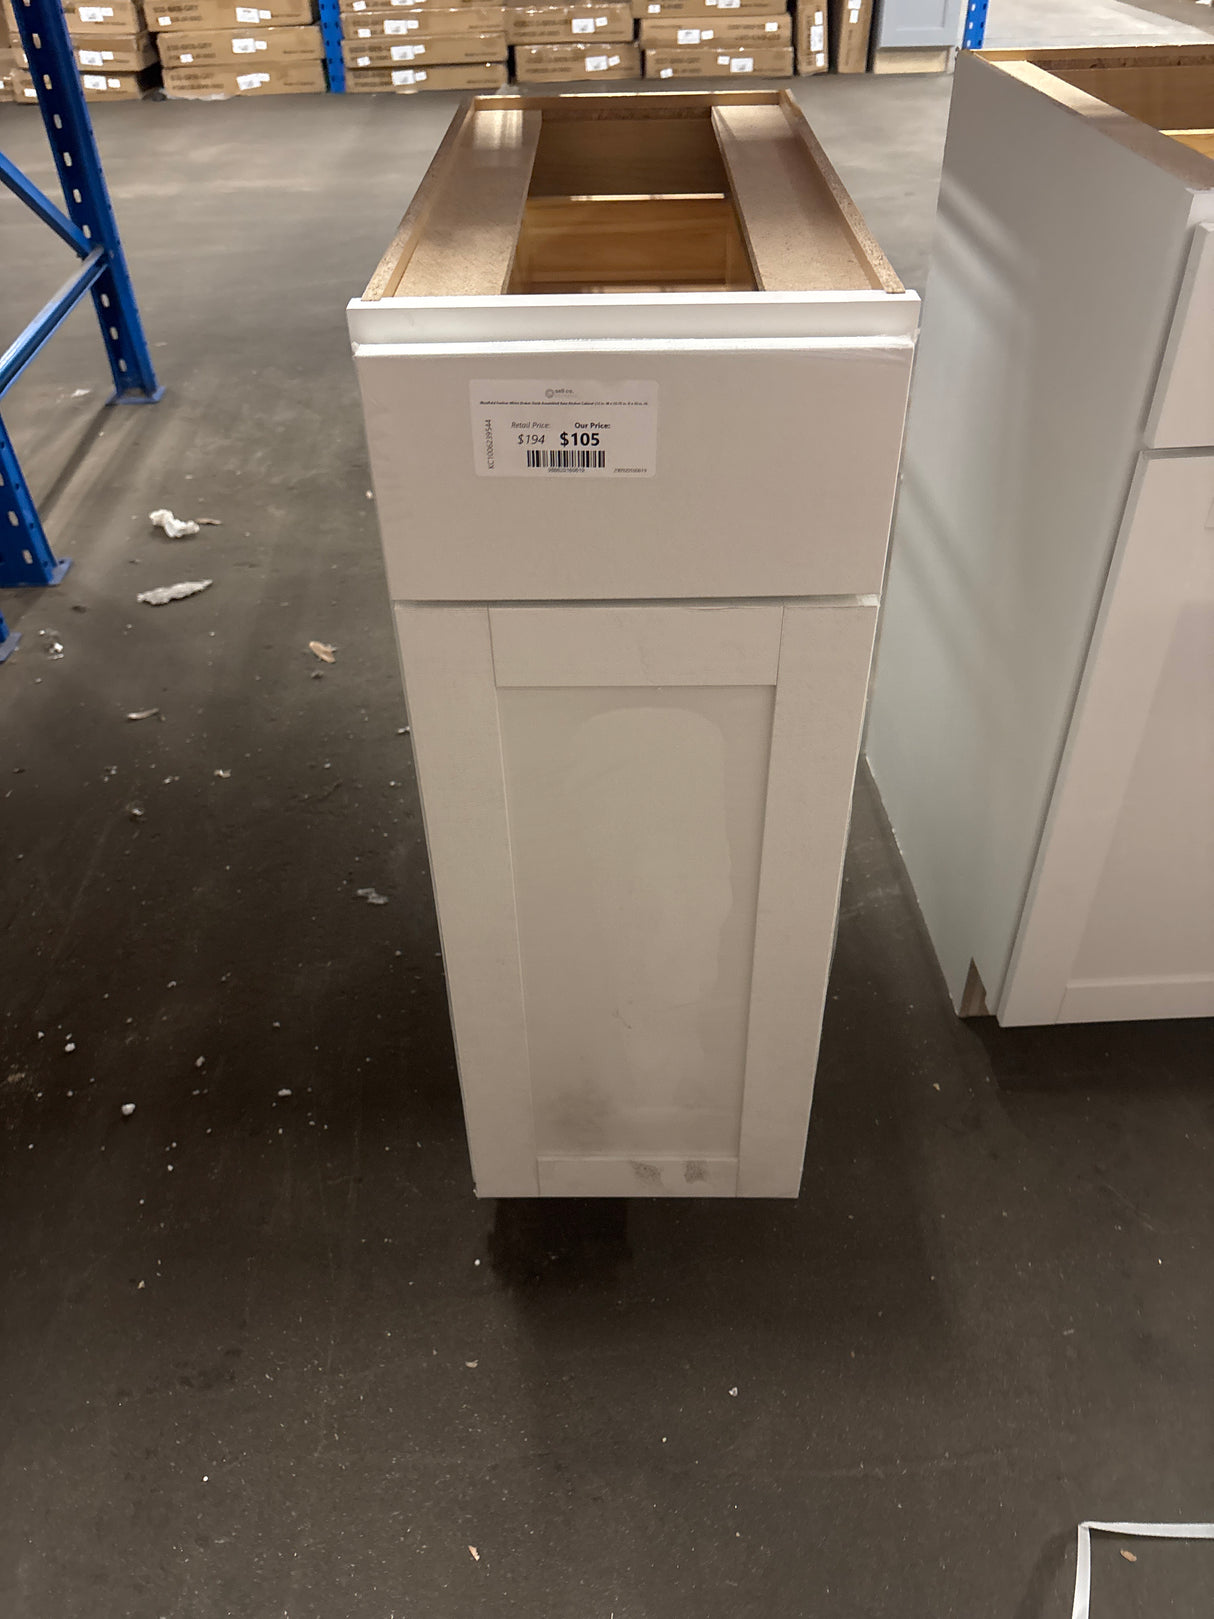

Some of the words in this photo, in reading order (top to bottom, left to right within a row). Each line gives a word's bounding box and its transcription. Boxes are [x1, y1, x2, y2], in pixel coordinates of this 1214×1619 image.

[511, 421, 531, 429] Retail
[531, 421, 551, 429] Price:
[517, 433, 546, 445] $194
[559, 431, 600, 447] $105
